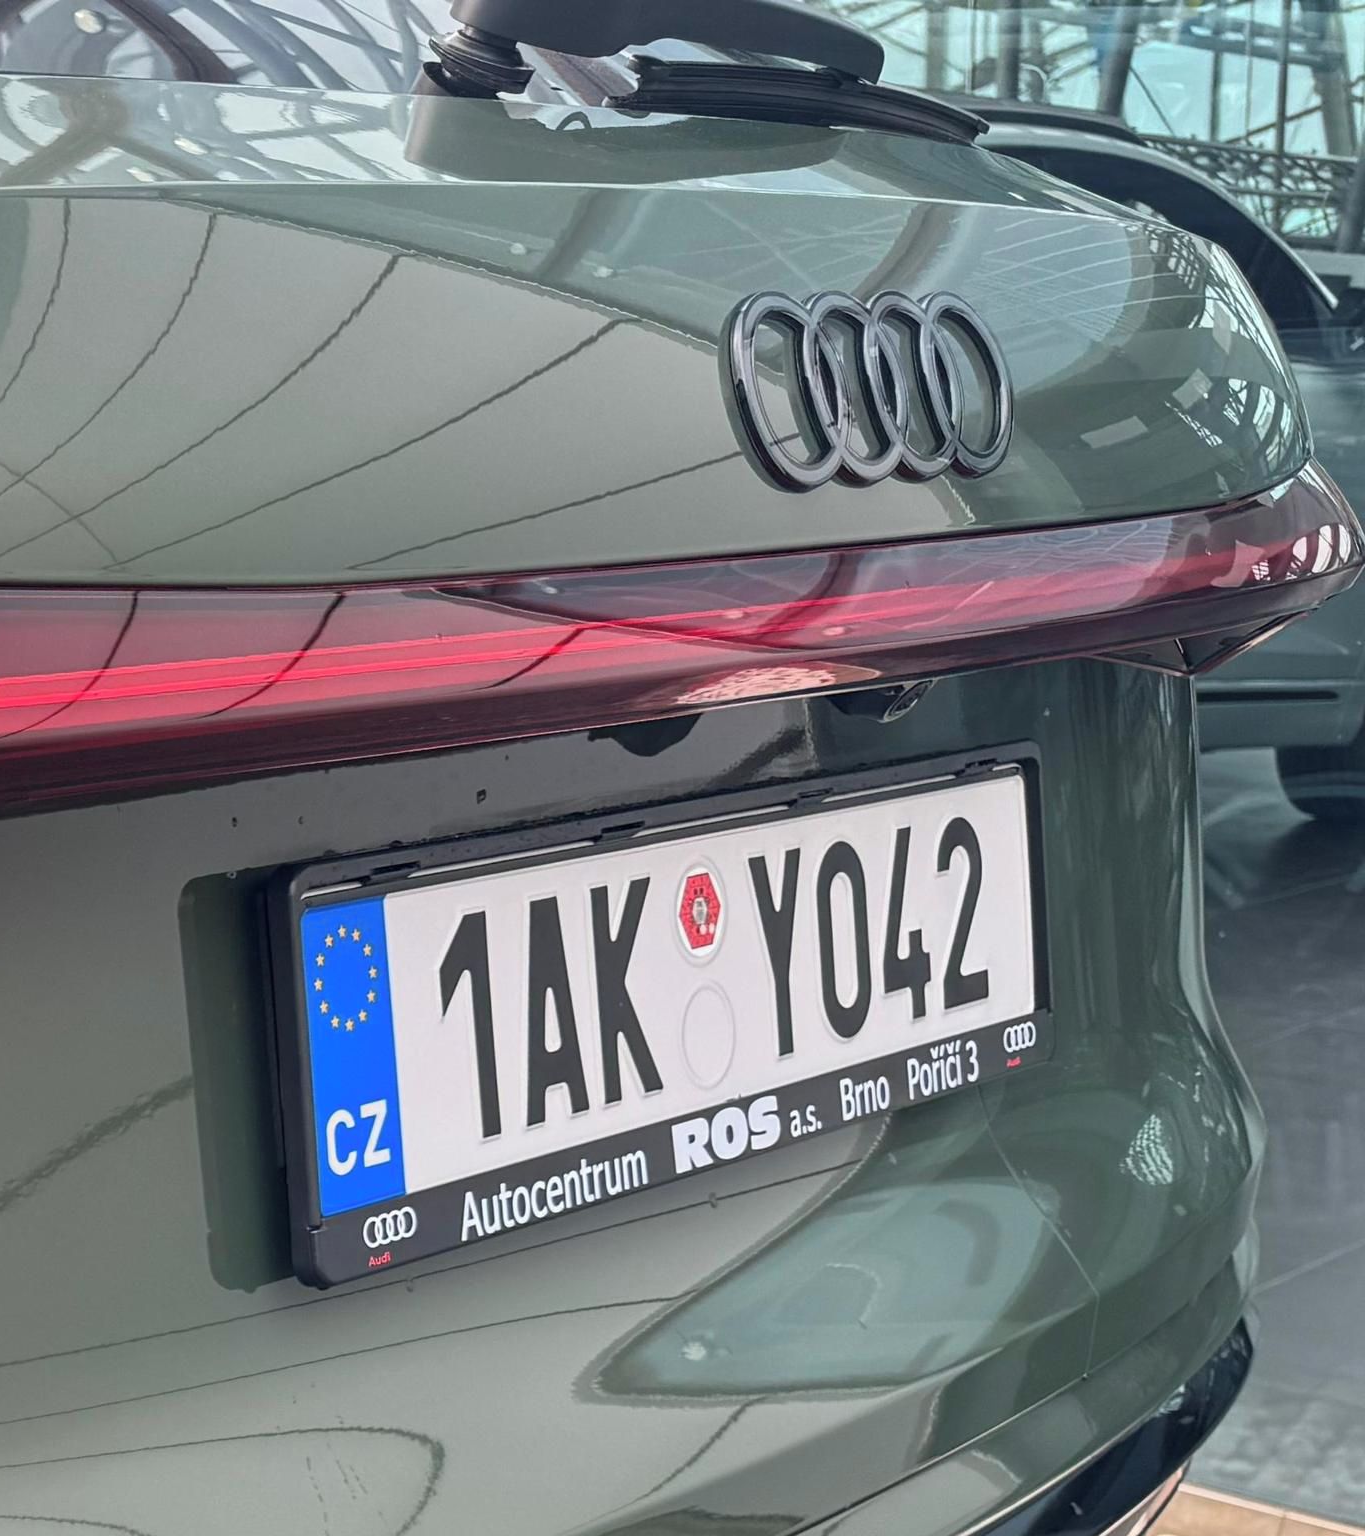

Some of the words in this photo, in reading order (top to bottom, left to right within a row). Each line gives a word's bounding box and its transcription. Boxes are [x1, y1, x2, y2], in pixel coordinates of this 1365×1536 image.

[438, 876, 665, 1139] 1AK
[325, 1098, 392, 1177] CZ
[460, 1149, 649, 1242] Autocentrum
[670, 1095, 782, 1175] ROS
[790, 1104, 823, 1138] a.s.
[839, 1075, 891, 1122] Brno
[906, 1039, 963, 1101] Poříčí
[966, 1040, 980, 1083] 3
[368, 1251, 392, 1267] Audi
